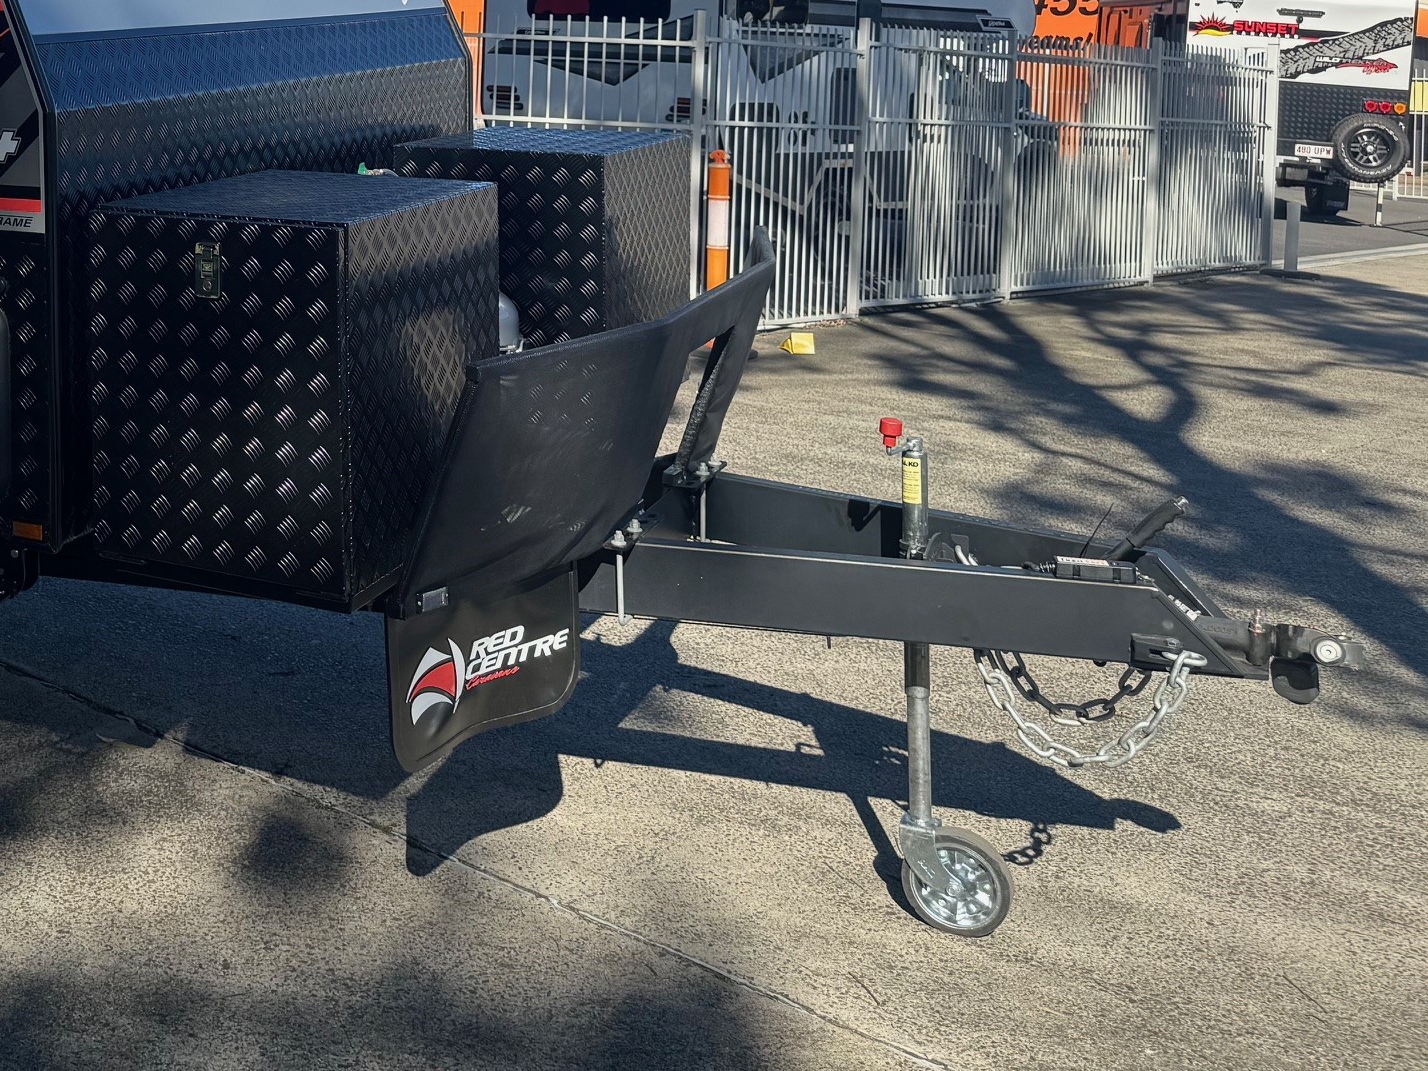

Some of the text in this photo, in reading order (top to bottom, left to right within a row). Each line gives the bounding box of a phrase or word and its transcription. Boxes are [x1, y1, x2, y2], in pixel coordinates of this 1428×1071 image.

[1233, 20, 1300, 36] SUNSET
[465, 628, 570, 680] CENTRE
[469, 625, 525, 660] RED
[465, 666, 520, 691] Caravans
